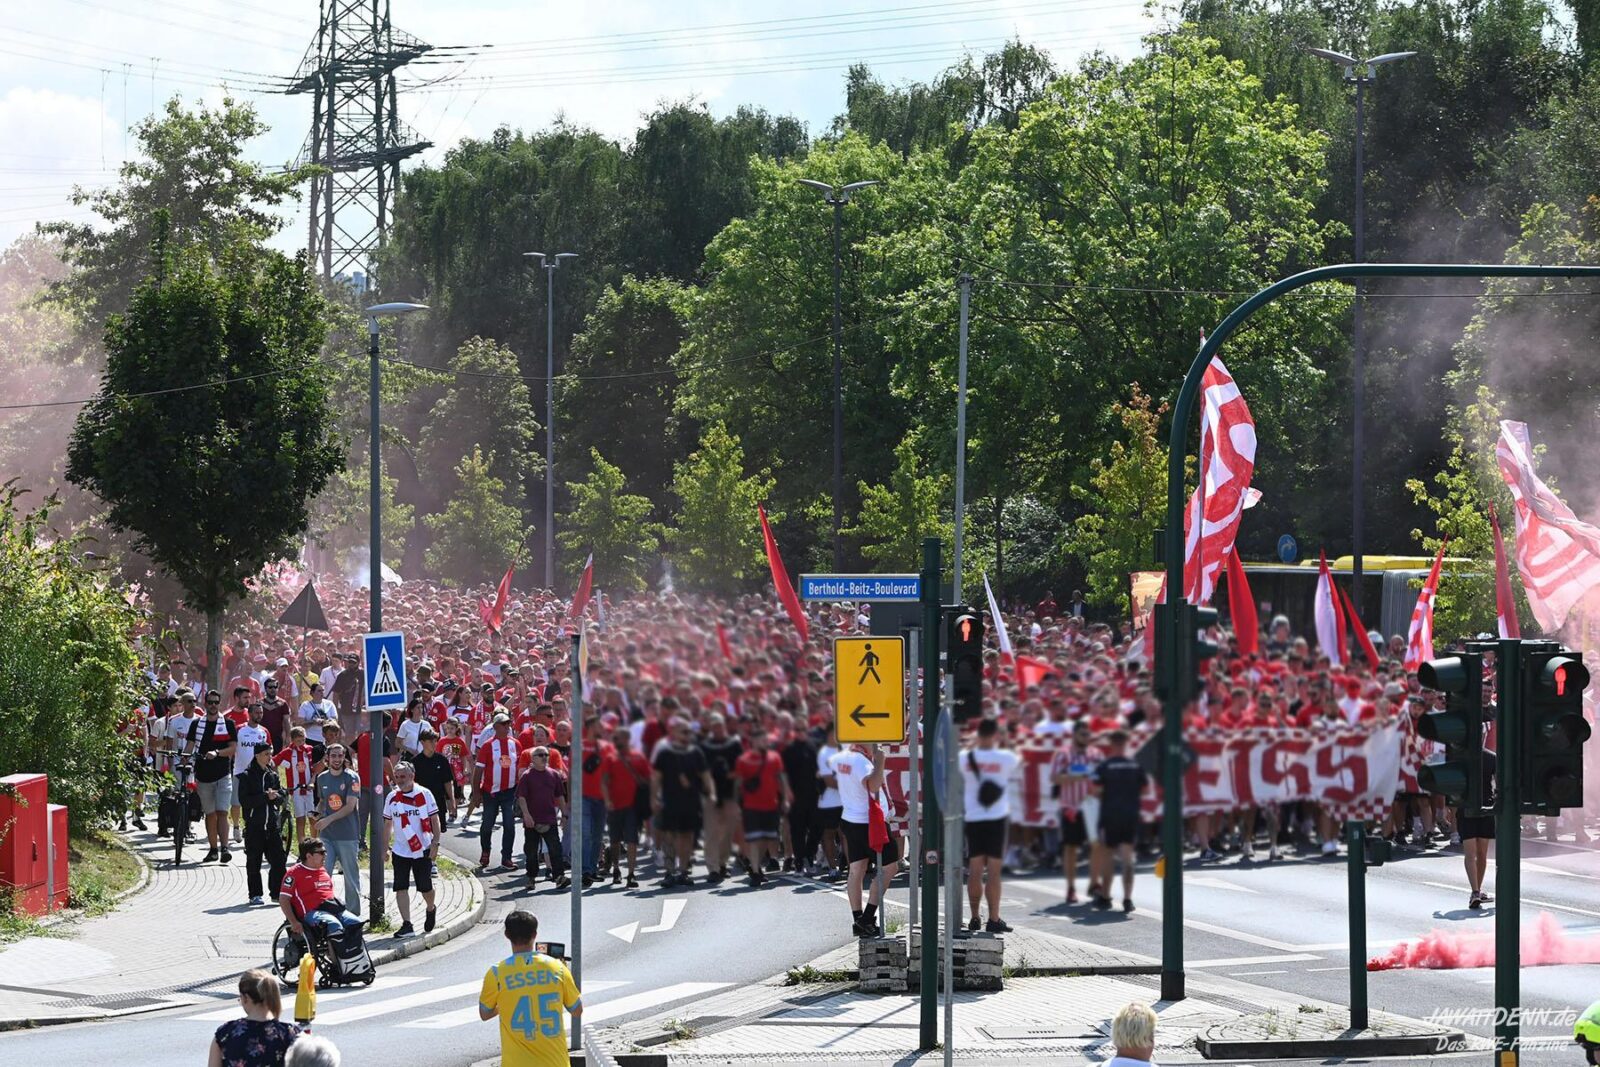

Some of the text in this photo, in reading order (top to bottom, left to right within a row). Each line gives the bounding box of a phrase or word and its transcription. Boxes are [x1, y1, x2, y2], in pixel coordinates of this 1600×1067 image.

[808, 582, 917, 595] Berthold-Beitz-Boulevard
[505, 970, 559, 990] ESSEN
[511, 992, 560, 1040] 45
